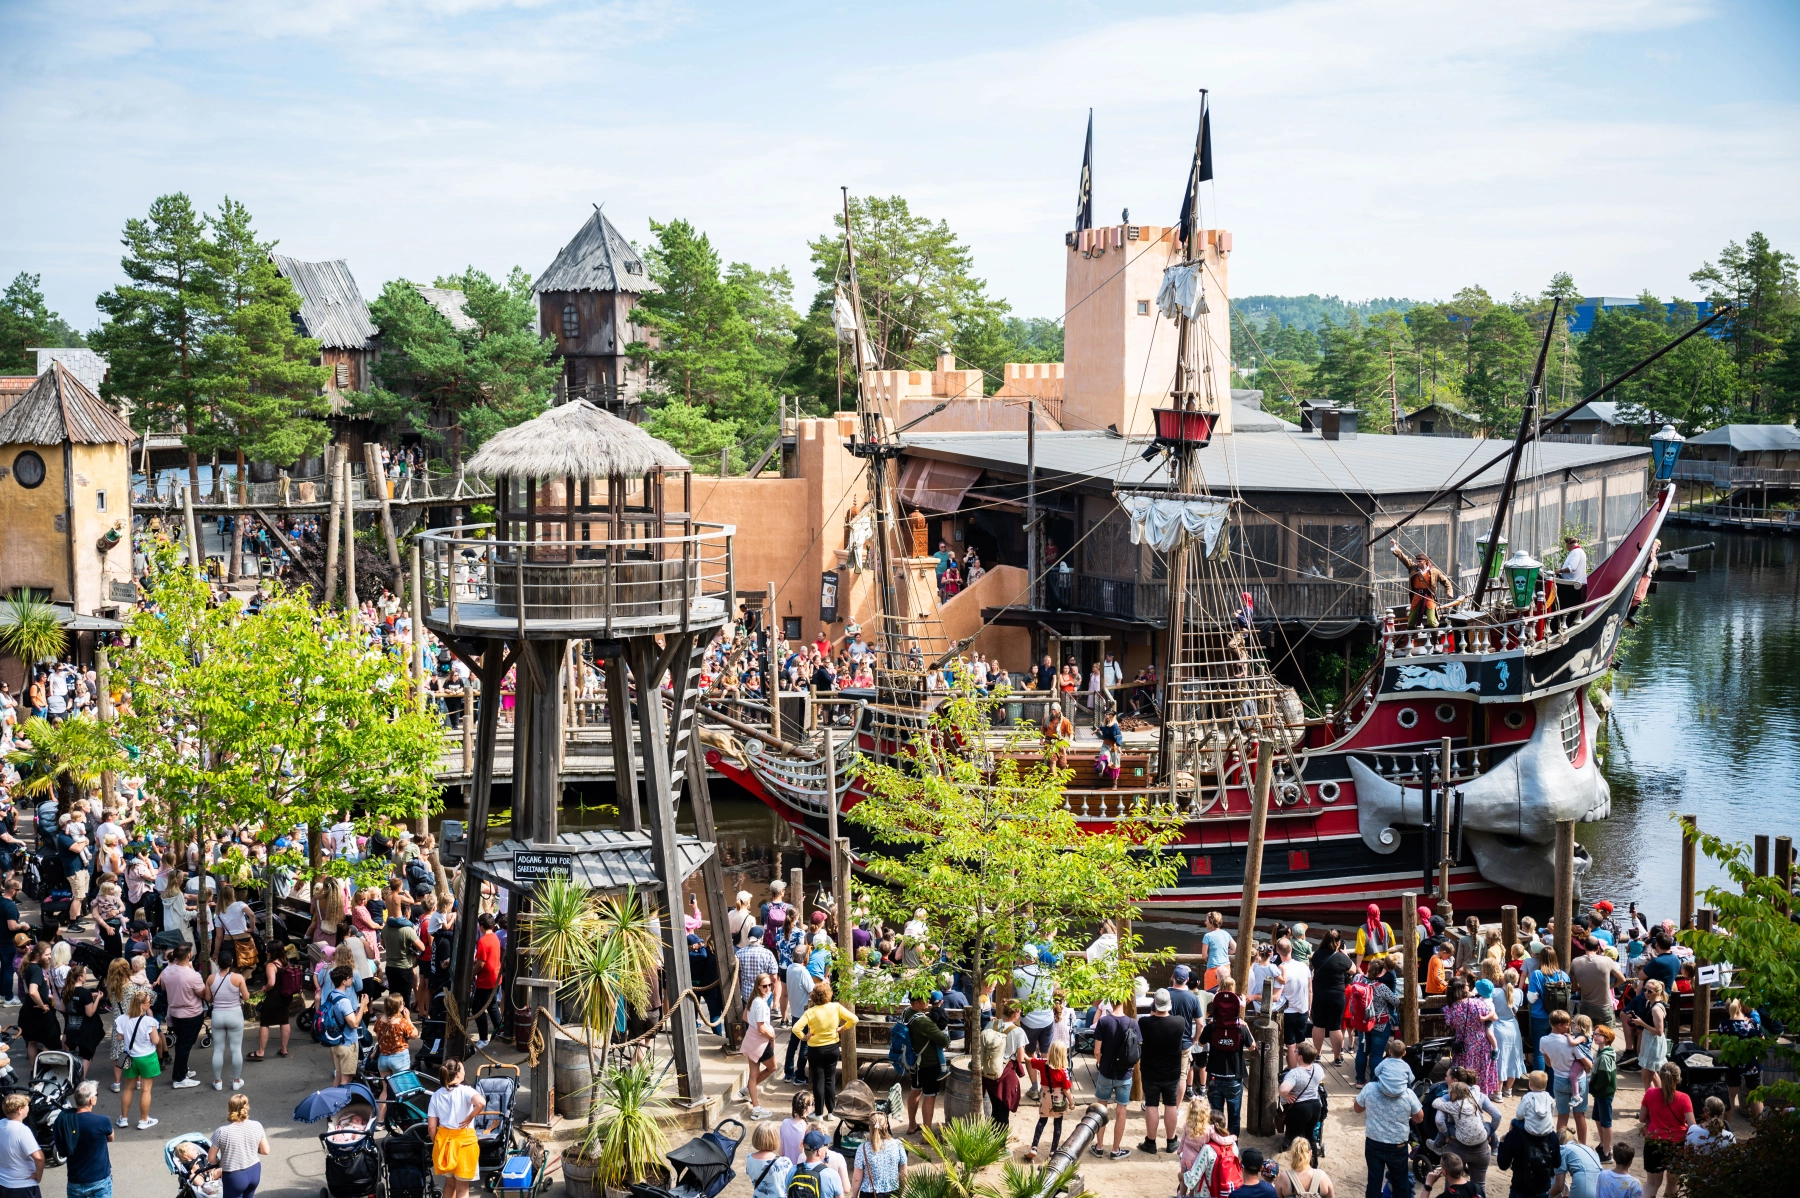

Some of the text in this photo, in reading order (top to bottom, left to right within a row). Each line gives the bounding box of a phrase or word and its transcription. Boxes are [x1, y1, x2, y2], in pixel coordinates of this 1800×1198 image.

[517, 855, 571, 865] ADGANG KUN FOR
[517, 865, 549, 873] SABELTANNS
